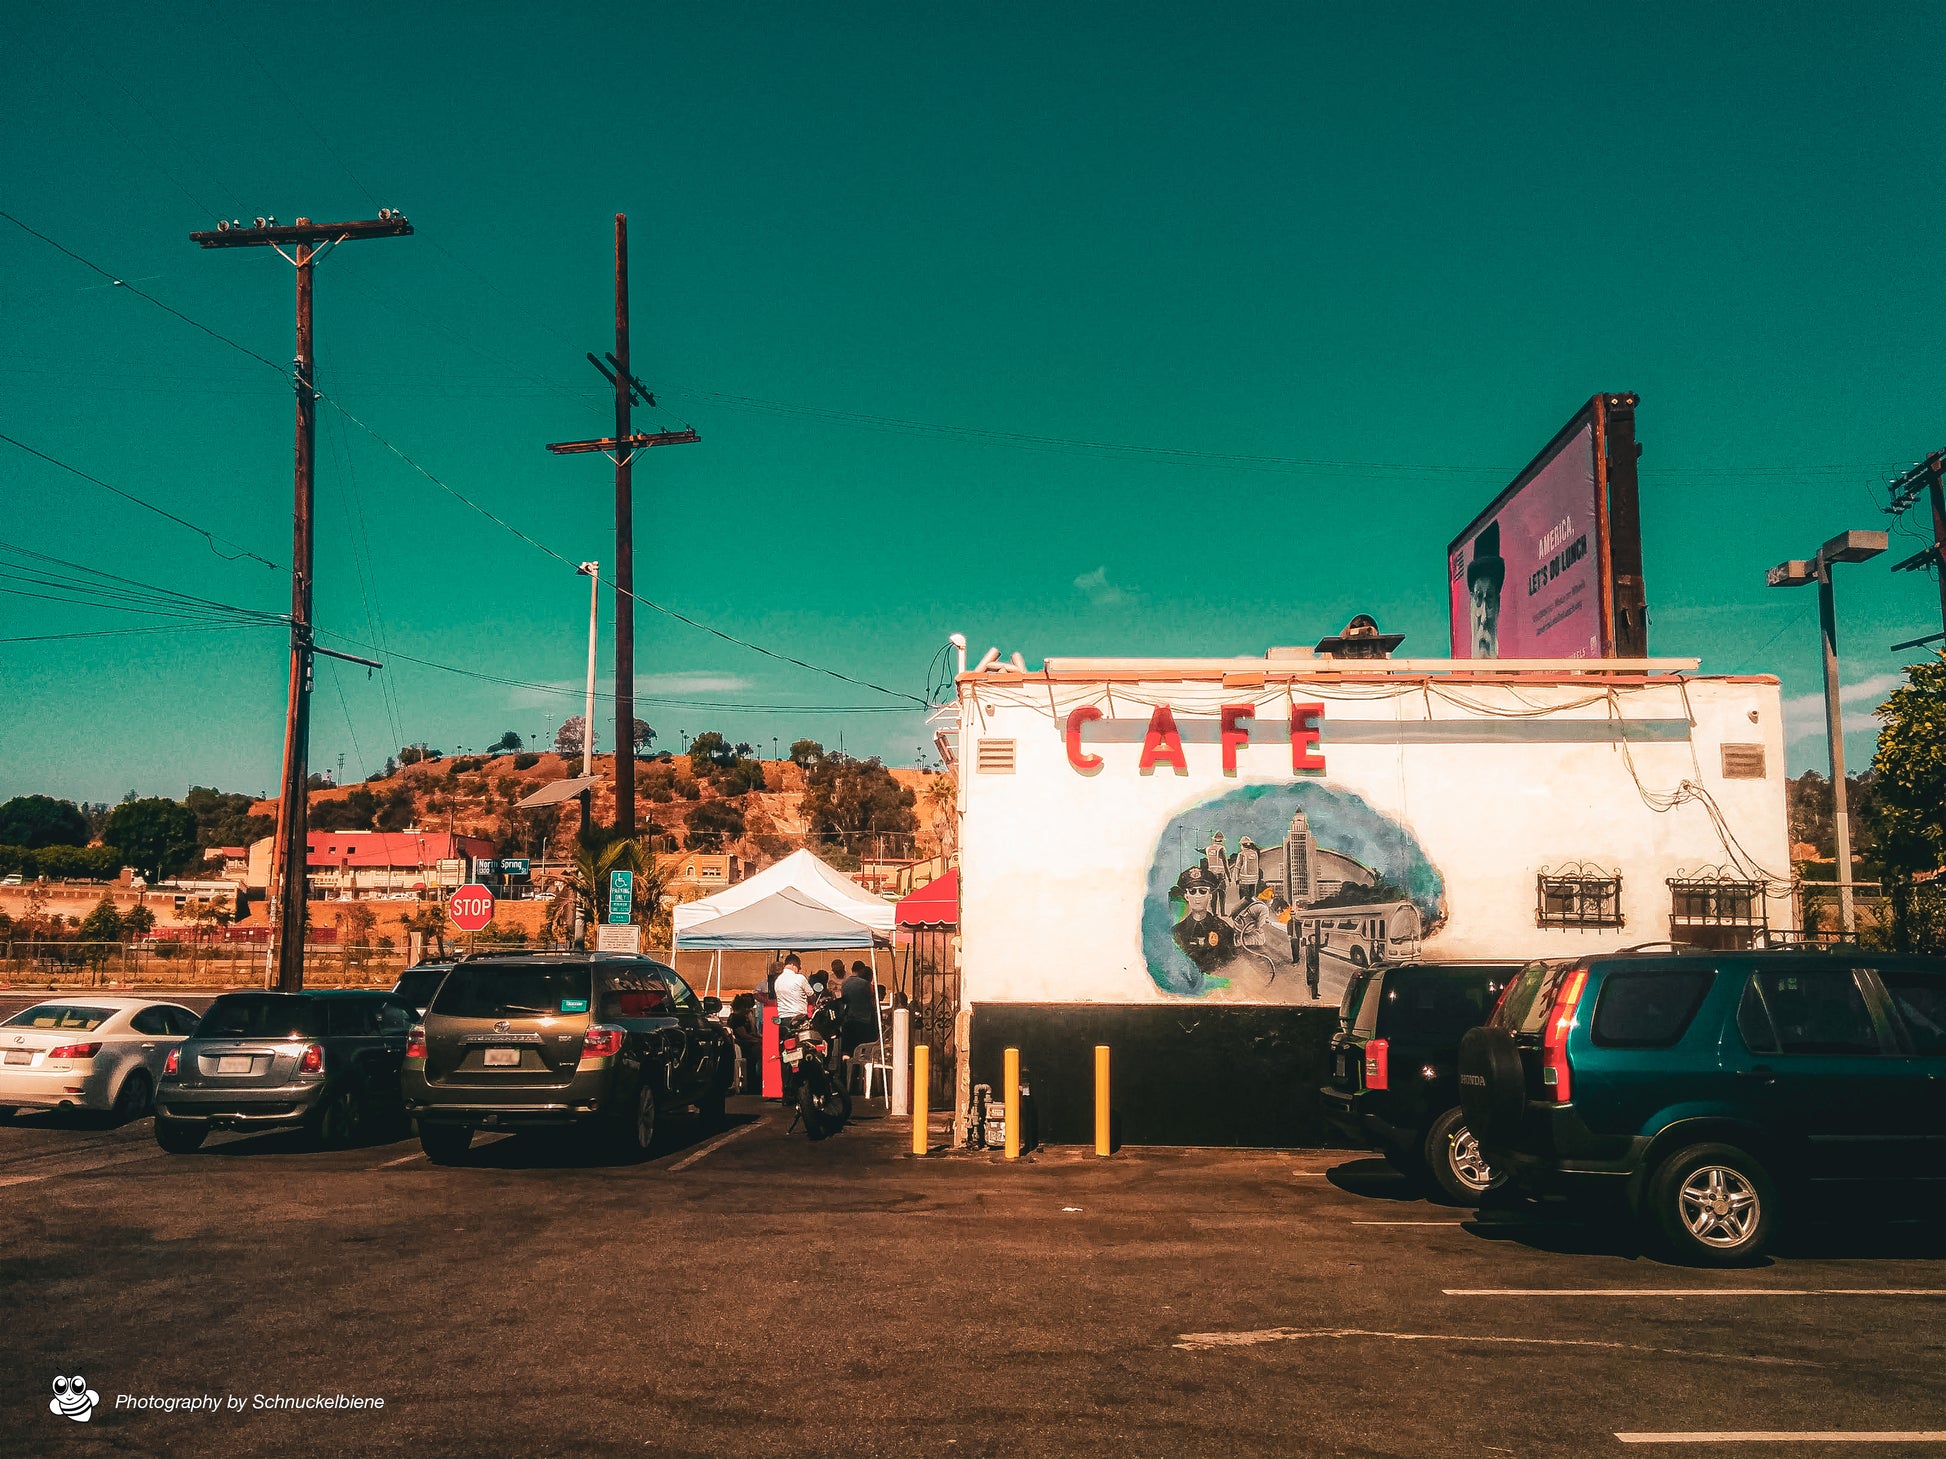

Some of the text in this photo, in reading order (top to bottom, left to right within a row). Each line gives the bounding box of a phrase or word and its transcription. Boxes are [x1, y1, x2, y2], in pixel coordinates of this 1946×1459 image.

[1538, 514, 1575, 560] AMERICA,
[1528, 534, 1587, 597] LET'S DO LUNCH
[1066, 702, 1326, 773] CAFE
[479, 860, 498, 868] North
[500, 860, 522, 870] Spring
[453, 898, 492, 916] STOP
[1460, 1074, 1486, 1086] HONDA
